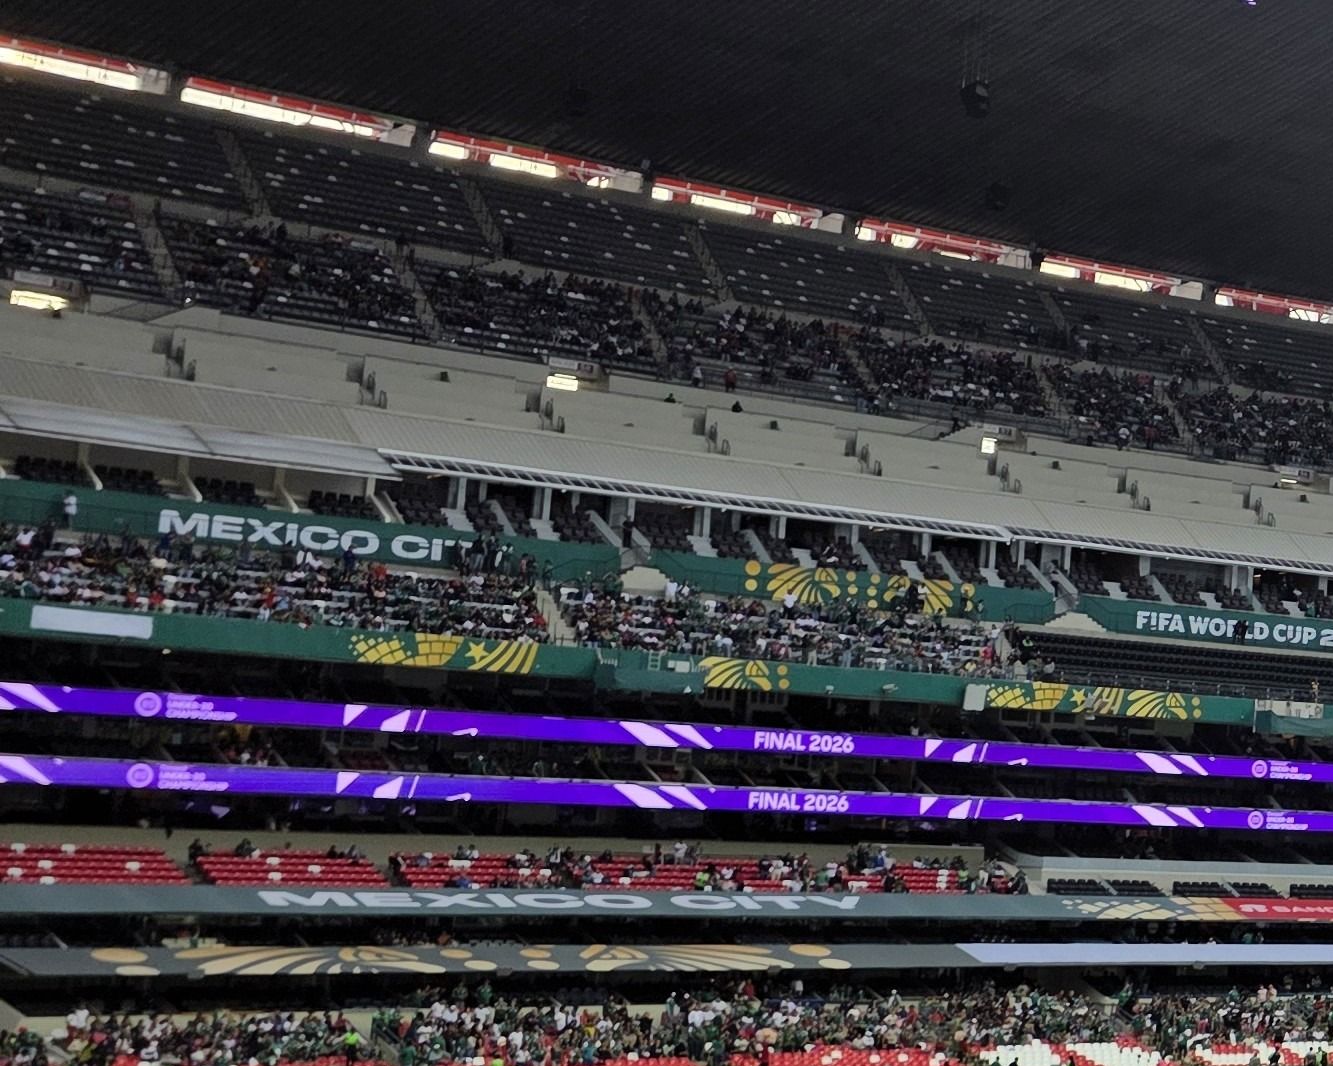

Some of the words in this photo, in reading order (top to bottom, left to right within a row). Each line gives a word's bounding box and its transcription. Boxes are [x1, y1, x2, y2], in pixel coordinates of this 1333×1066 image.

[158, 509, 380, 555] MEXICO
[391, 535, 474, 562] CIT
[1136, 610, 1185, 634] FIFA
[1272, 623, 1316, 646] CUP
[754, 731, 805, 751] FINAL
[809, 733, 854, 753] 2026
[749, 792, 800, 811] FINAL
[804, 792, 849, 812] 2026
[258, 890, 651, 908] MEXICO
[668, 893, 860, 910] CITY
